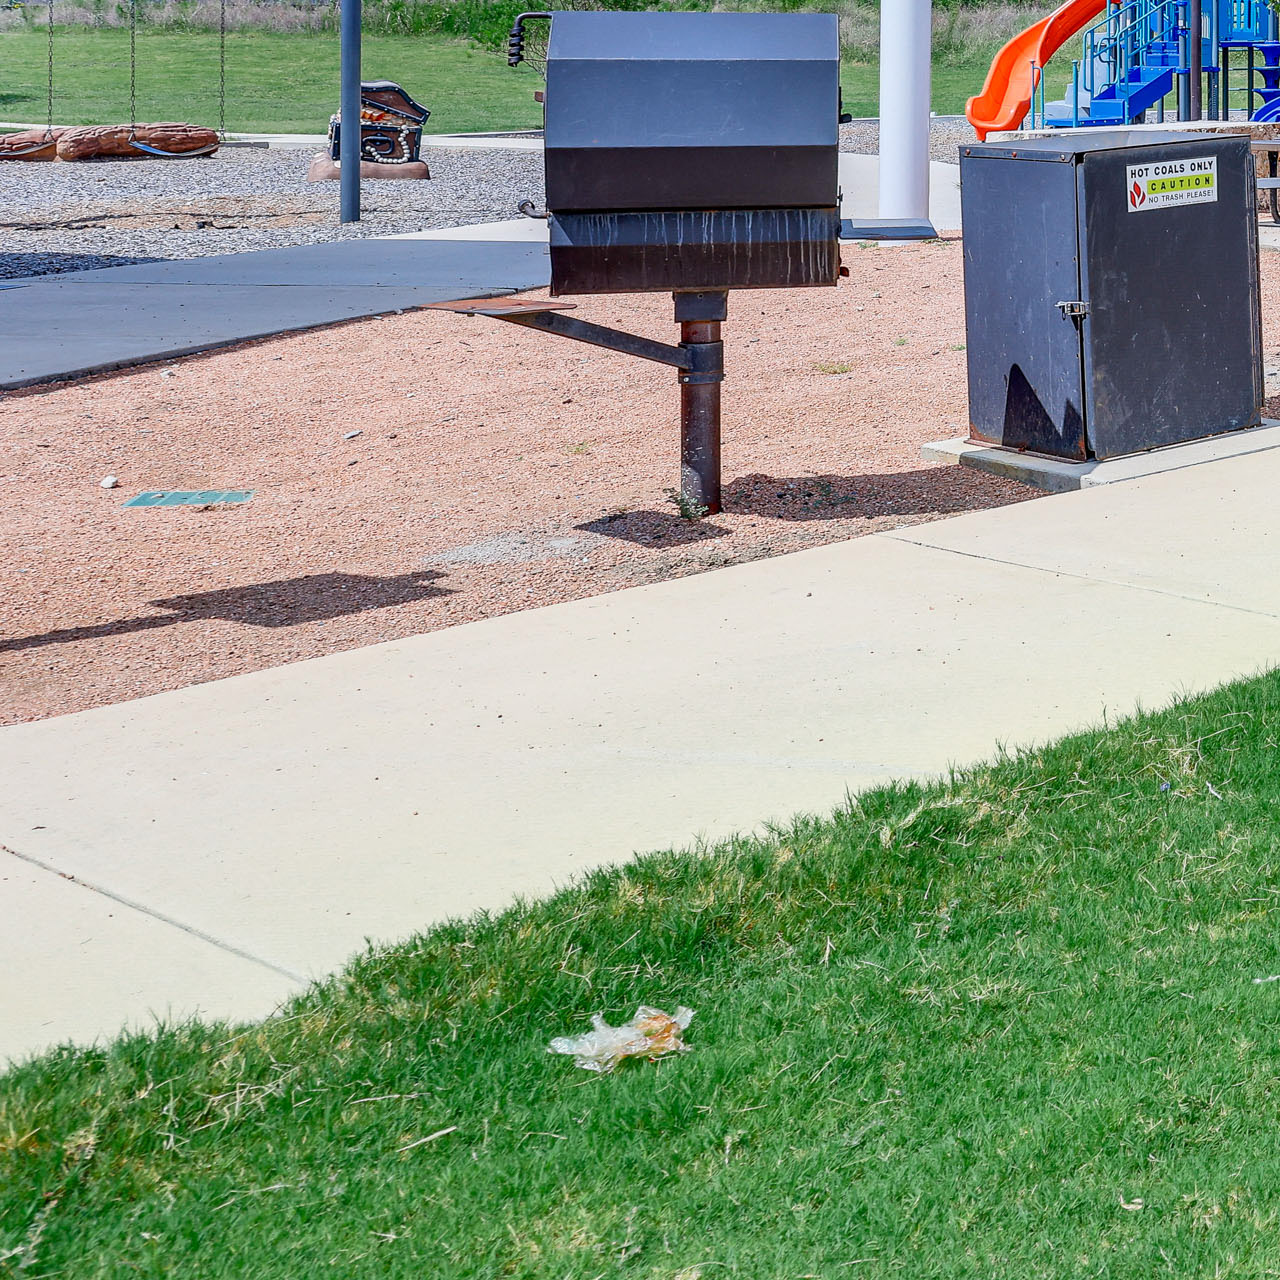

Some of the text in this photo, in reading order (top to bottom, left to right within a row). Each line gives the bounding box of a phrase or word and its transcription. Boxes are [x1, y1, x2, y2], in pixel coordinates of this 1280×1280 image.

[1130, 160, 1214, 179] HOT COALS ONLY
[1151, 176, 1210, 191] CAUTION
[1148, 196, 1159, 204] NO
[1162, 193, 1184, 202] TRASH
[1186, 189, 1214, 199] PLEASE!
